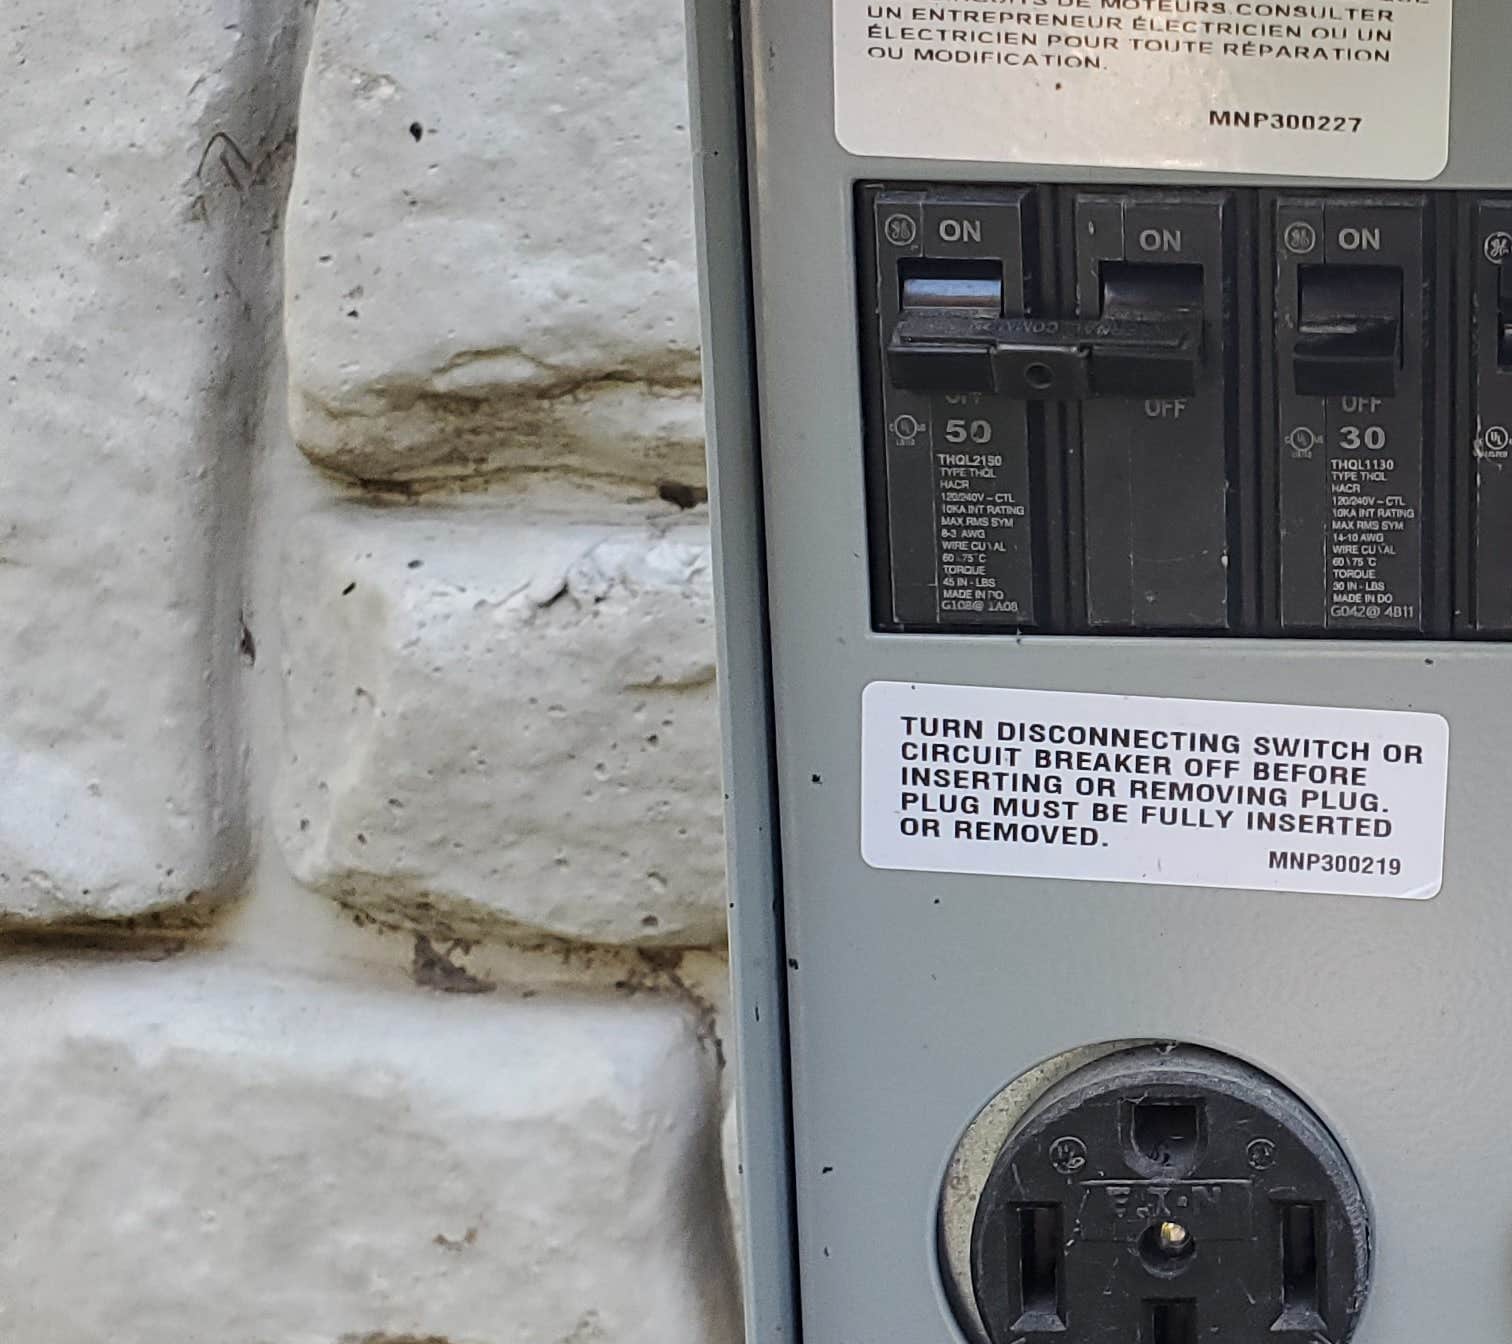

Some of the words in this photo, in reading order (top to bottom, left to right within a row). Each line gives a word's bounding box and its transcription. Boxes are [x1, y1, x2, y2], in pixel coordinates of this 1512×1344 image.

[867, 4, 902, 20] UN
[911, 7, 1123, 31] ENTREPRENEUR
[1132, 12, 1302, 39] ÉLECTRICIEN
[1310, 26, 1348, 40] OU
[1357, 27, 1392, 43] UN
[1235, 2, 1395, 24] CONSULTER
[867, 21, 1038, 47] ÉLECTRICIEN
[1047, 33, 1119, 51] POUR
[1128, 37, 1214, 55] TOUTE
[1223, 40, 1390, 63] RÉPARATION
[867, 46, 904, 61] OU
[913, 47, 1108, 70] MODIFICATION.
[1209, 109, 1363, 133] MNP300227
[938, 220, 982, 243] ON
[1138, 229, 1182, 252] ON
[1338, 228, 1381, 251] ON
[1144, 399, 1188, 419] OFF
[945, 419, 992, 444] 50
[1339, 426, 1386, 450] 30
[937, 453, 1003, 467] THQL2150
[1331, 459, 1395, 471] THQL1130
[940, 480, 970, 490] HACR
[1332, 484, 1361, 494] HACR
[961, 530, 986, 539] AWG
[1360, 533, 1384, 543] AWG
[943, 565, 986, 576] TORQUE
[1333, 569, 1376, 579] TORQUE
[900, 715, 983, 740] TURN
[997, 721, 1240, 755] DISCONNECTING
[1253, 736, 1370, 762] SWITCH
[1382, 743, 1423, 765] OR
[901, 741, 1022, 767] CIRCUIT
[1034, 748, 1172, 776] BREAKER
[1184, 757, 1240, 779] OFF
[1253, 761, 1367, 787] BEFORE
[901, 766, 1062, 795] INSERTING
[1075, 776, 1116, 798] OR
[1129, 779, 1287, 808] REMOVING
[1301, 789, 1389, 813] PLUG.
[901, 791, 980, 815] PLUG
[993, 796, 1080, 821] MUST
[1092, 802, 1128, 824] BE
[1141, 805, 1234, 829] FULLY
[1247, 811, 1392, 838] INSERTED
[899, 817, 941, 838] OR
[954, 819, 1109, 847] REMOVED.
[1268, 850, 1401, 876] MNP300219
